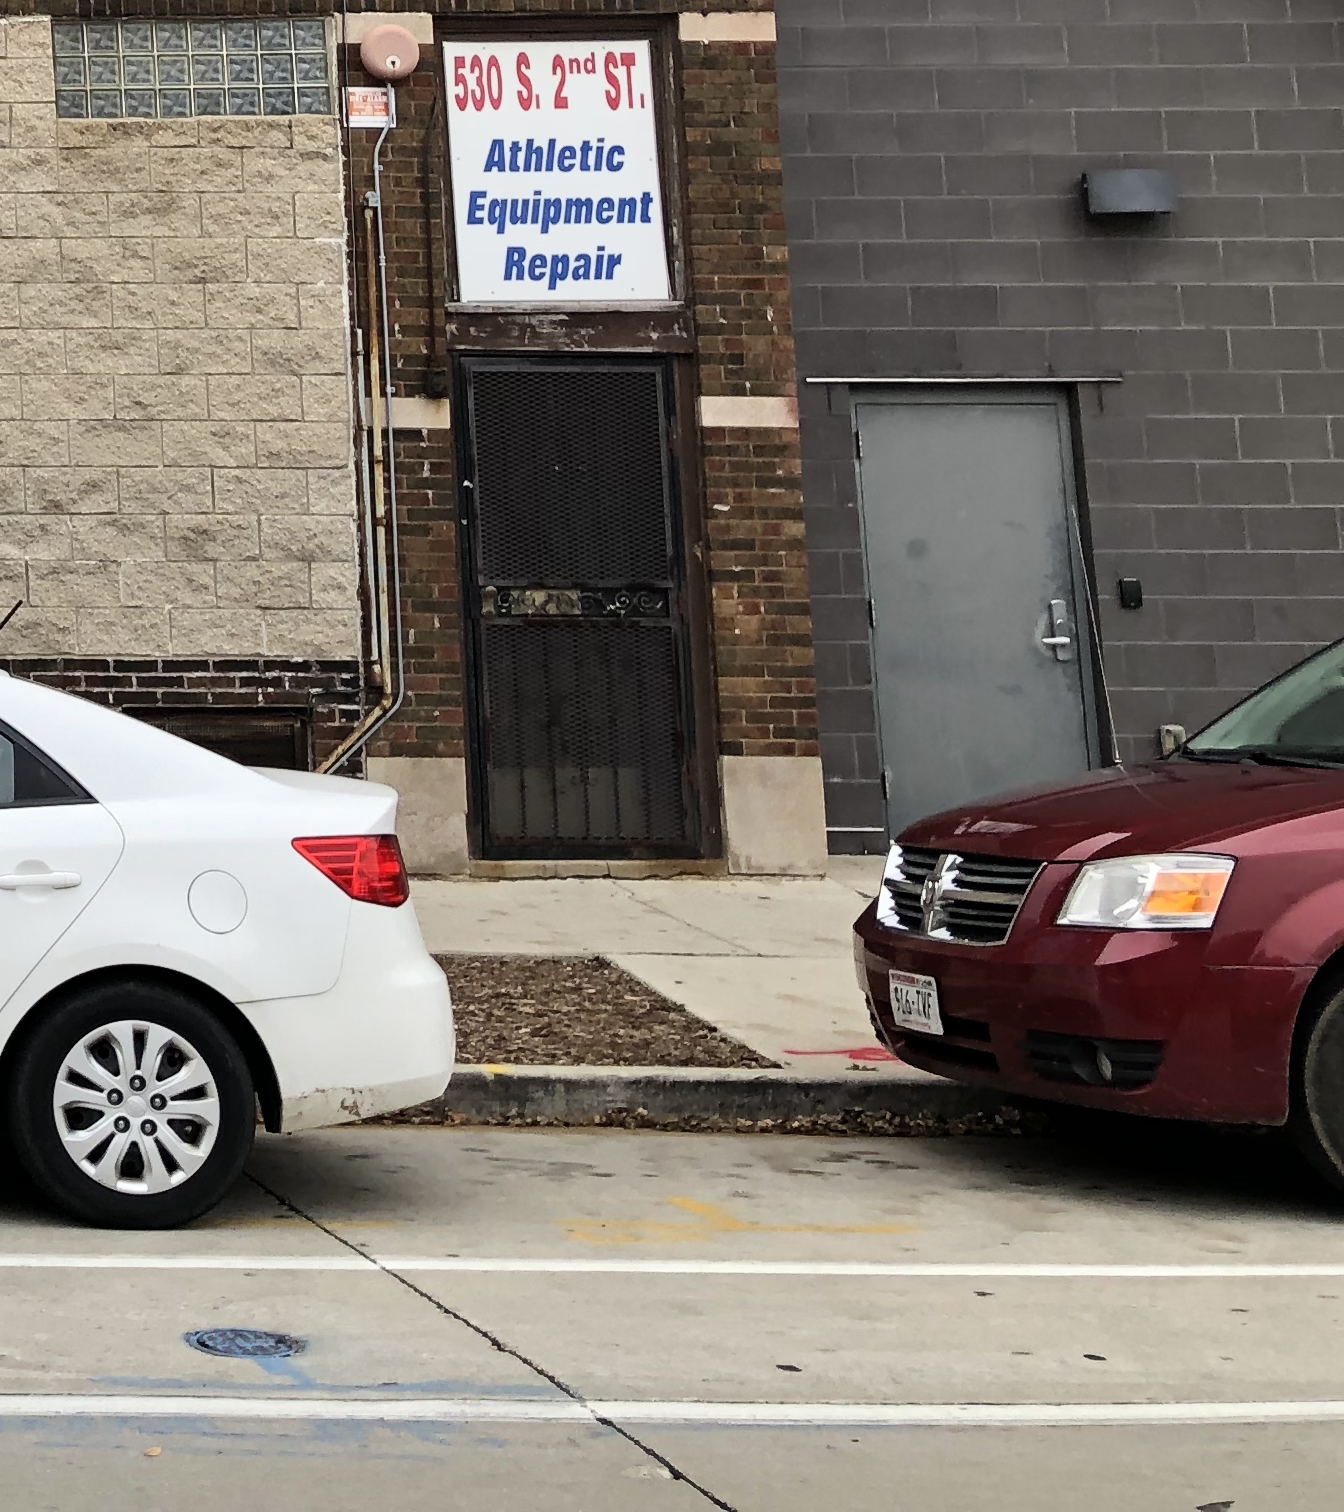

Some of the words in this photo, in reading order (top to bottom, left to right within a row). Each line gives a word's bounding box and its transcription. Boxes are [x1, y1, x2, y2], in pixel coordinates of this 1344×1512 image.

[453, 54, 503, 112] 530
[516, 51, 541, 111] S.
[552, 51, 597, 110] 2nd
[604, 51, 646, 111] ST.
[483, 138, 625, 172] Athletic
[467, 190, 653, 234] Equipment
[503, 245, 622, 291] Repair
